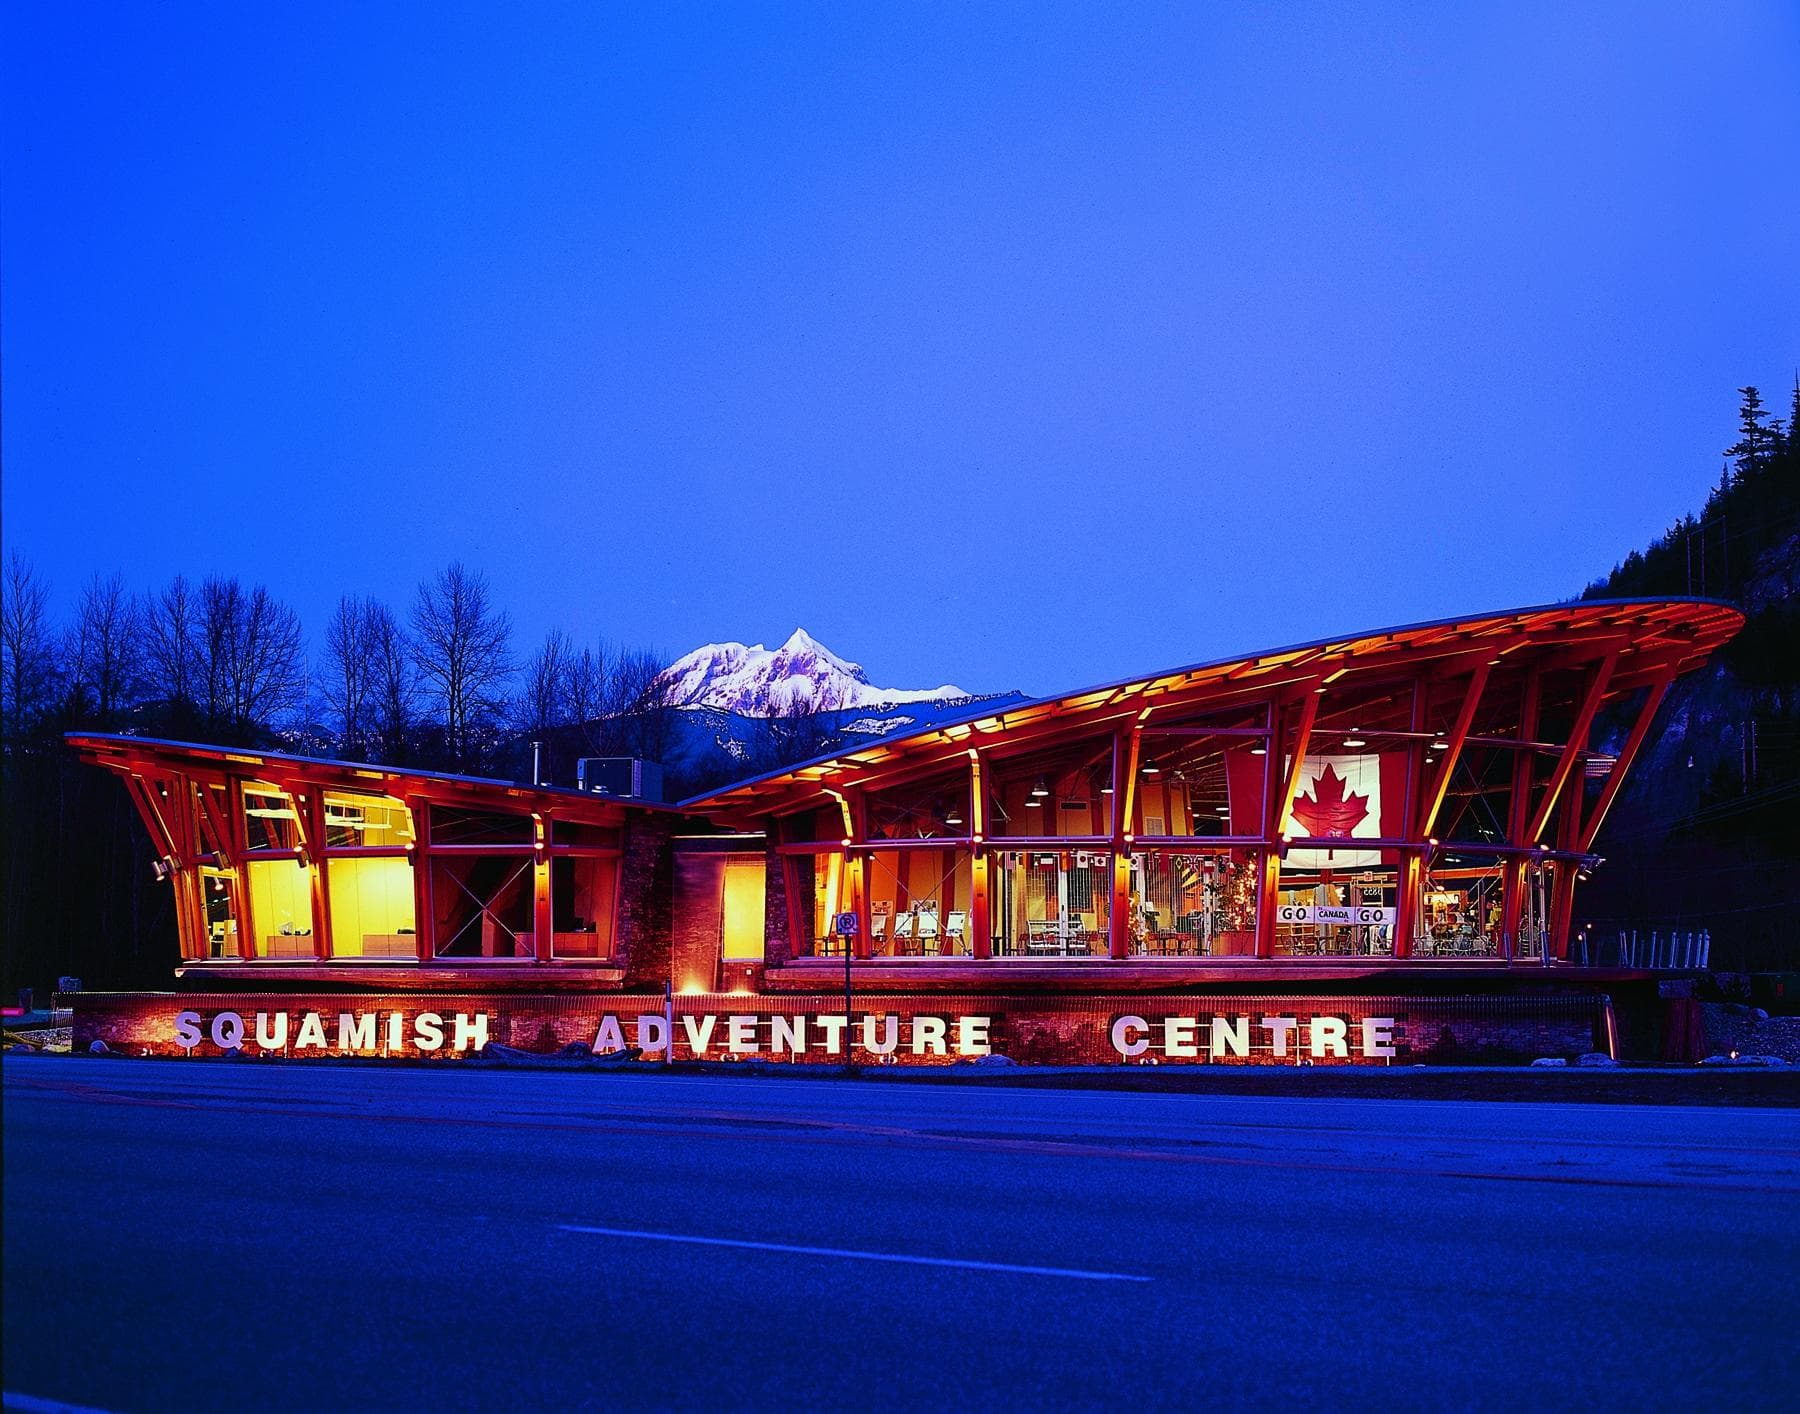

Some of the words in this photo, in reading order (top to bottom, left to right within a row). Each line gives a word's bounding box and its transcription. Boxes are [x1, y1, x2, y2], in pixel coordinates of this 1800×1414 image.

[1282, 907, 1307, 920] GO
[1318, 910, 1349, 919] CANADA
[1360, 909, 1384, 922] GO
[174, 1011, 489, 1051] SQUAMISH
[591, 1014, 992, 1056] ADVENTURE
[1111, 1015, 1396, 1057] CENTRE
